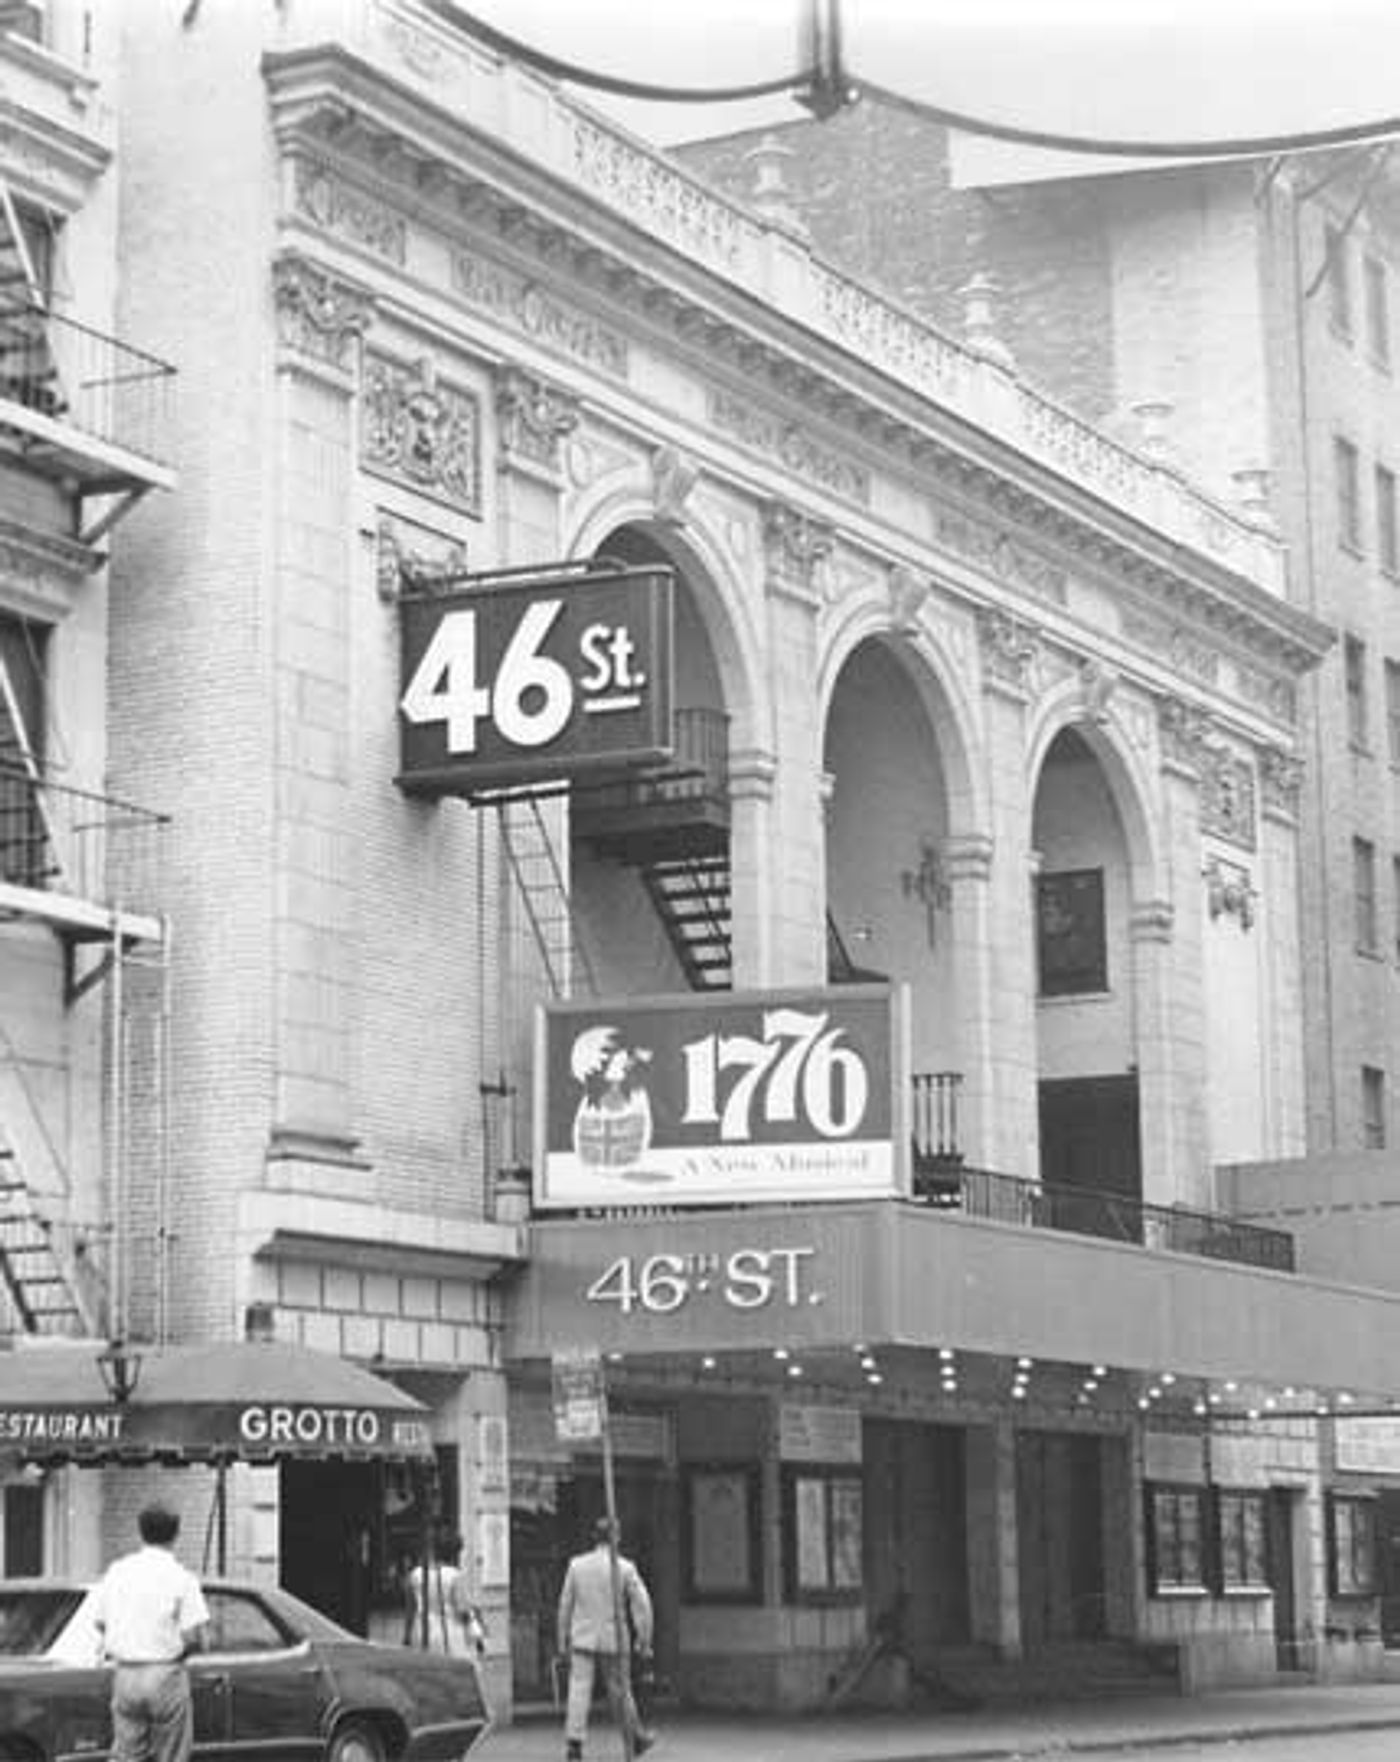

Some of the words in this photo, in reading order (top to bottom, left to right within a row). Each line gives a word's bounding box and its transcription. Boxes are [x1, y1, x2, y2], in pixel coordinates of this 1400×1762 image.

[400, 600, 573, 753] 46
[580, 623, 646, 691] St.
[680, 1008, 868, 1141] 1776
[725, 1247, 822, 1308] ST.
[240, 1406, 379, 1442] GROTTO
